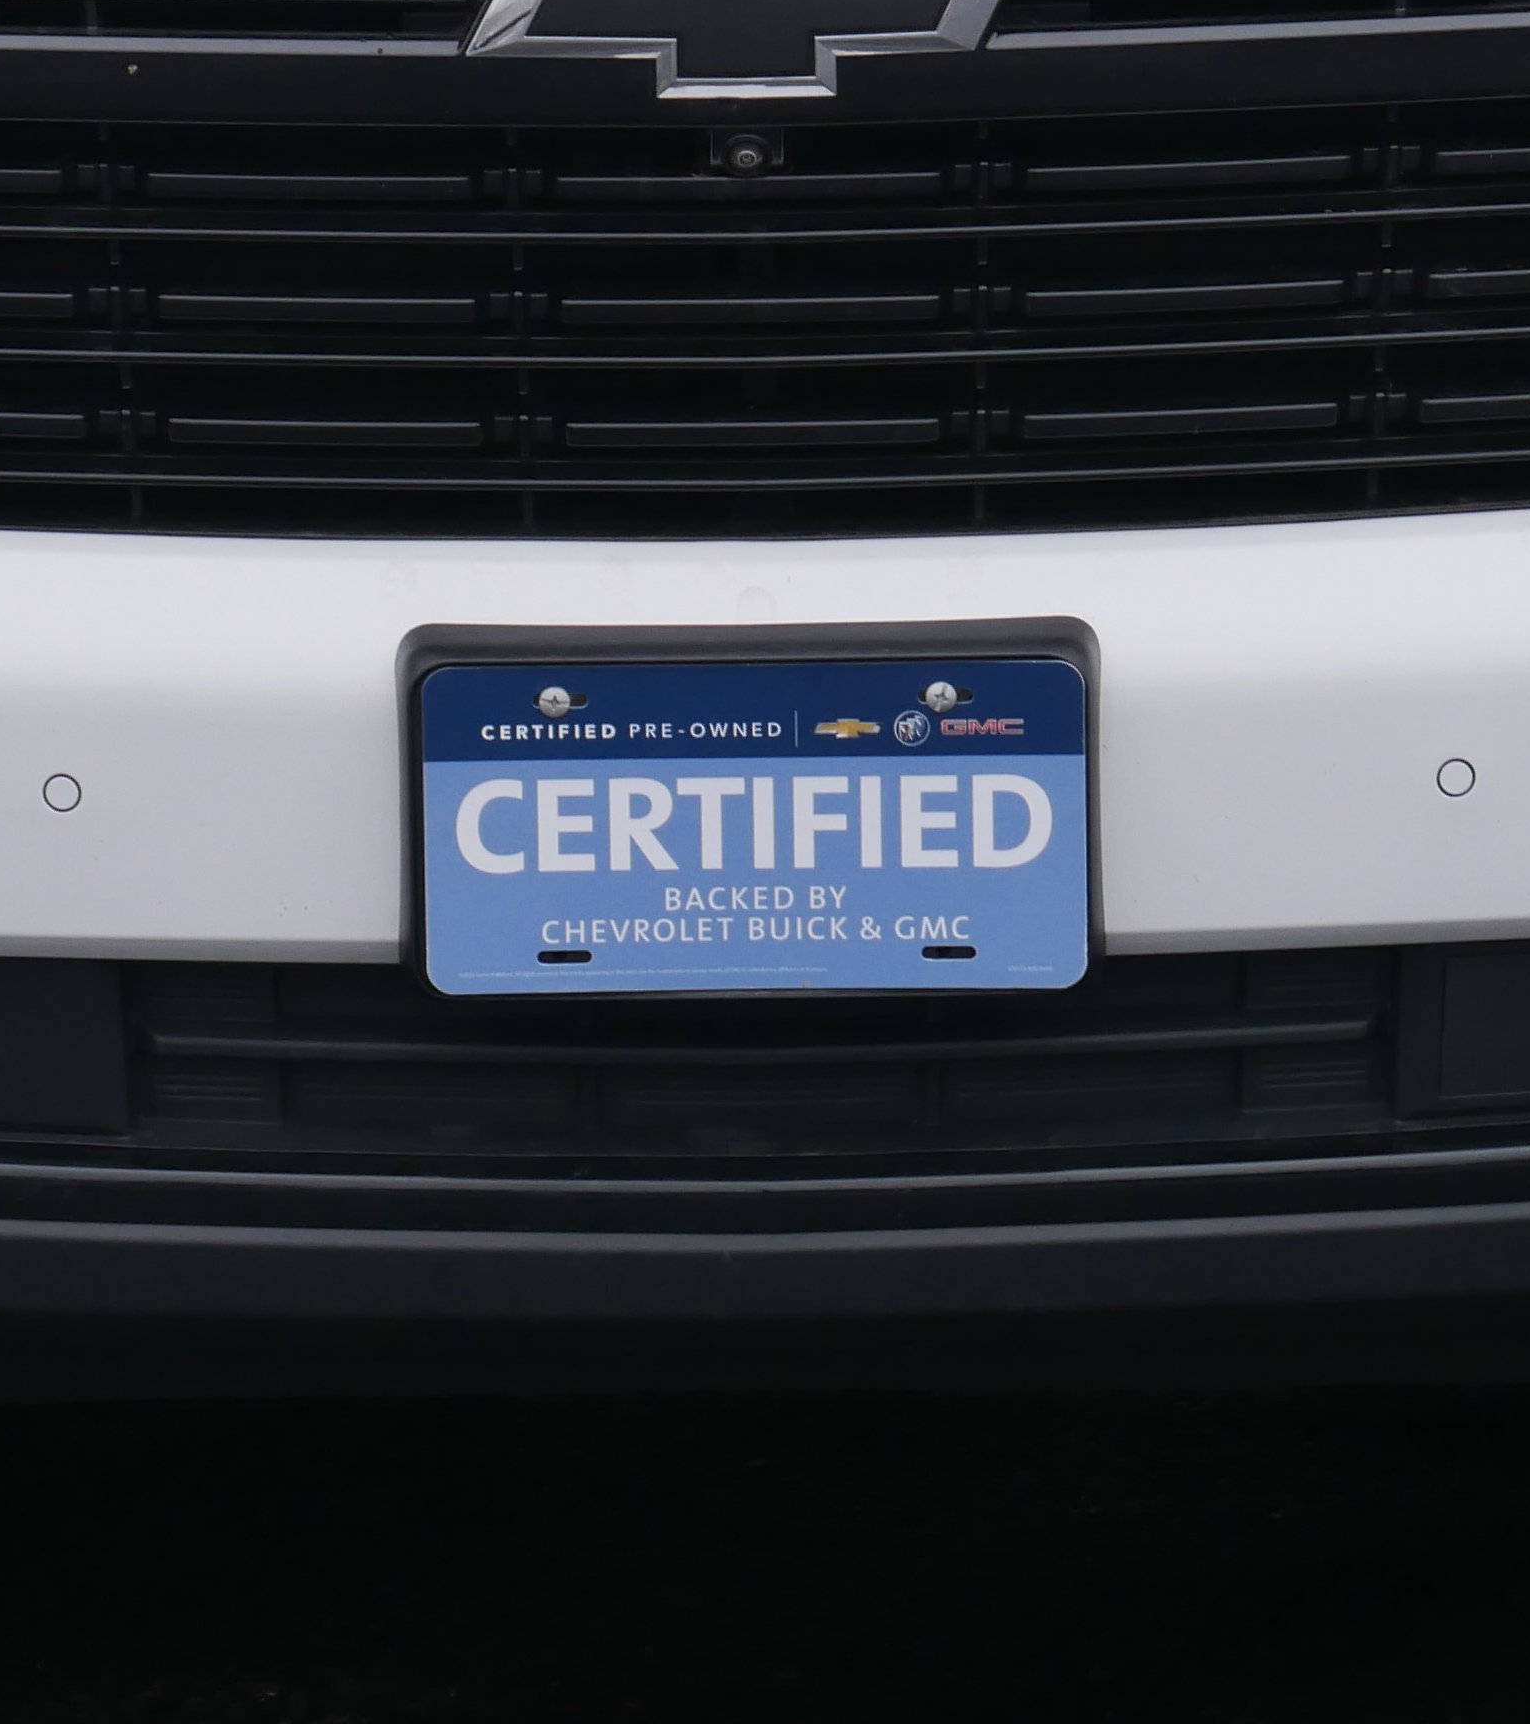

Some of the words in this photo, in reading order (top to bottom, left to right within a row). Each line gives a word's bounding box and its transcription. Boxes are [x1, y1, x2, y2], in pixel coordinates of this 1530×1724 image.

[481, 724, 616, 740] CERTIFIED
[629, 722, 782, 738] PRE-OWNED
[940, 718, 1025, 736] GMC
[455, 775, 1053, 874] CERTIFIED
[664, 887, 795, 910] BACKED
[809, 886, 848, 909] BY
[541, 917, 734, 944] CHEVROLET
[748, 916, 849, 940] BUICK
[860, 916, 882, 940] &
[894, 915, 970, 940] GMC
